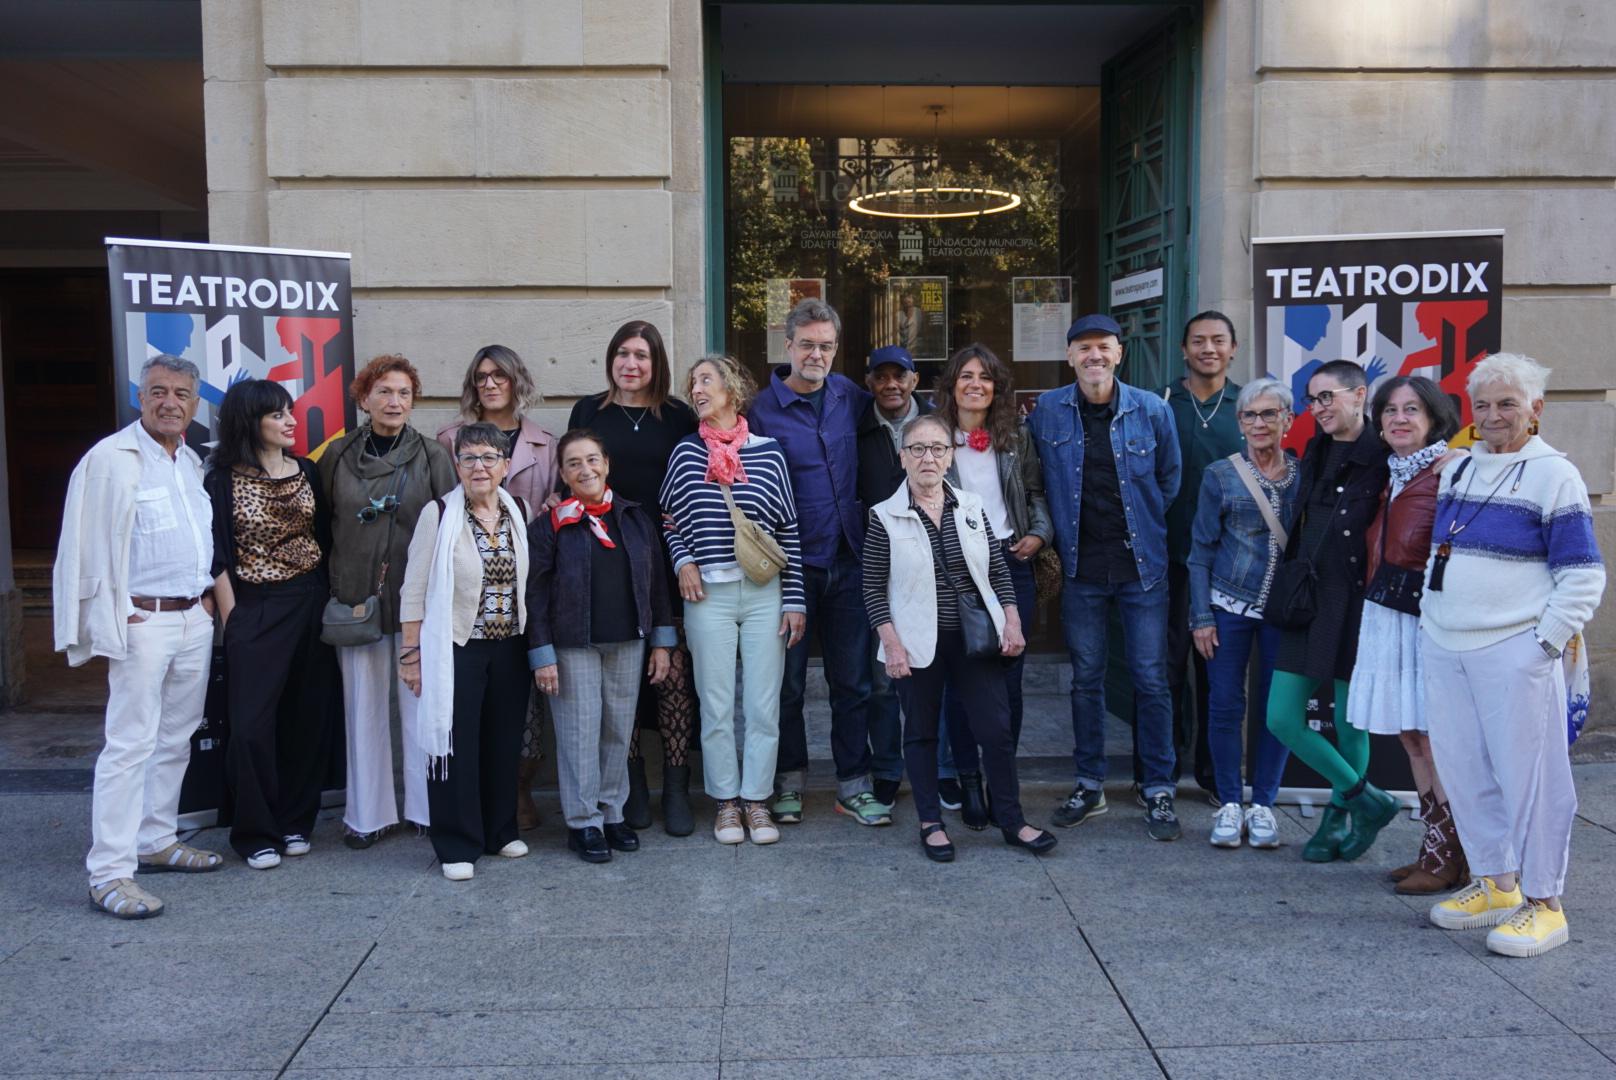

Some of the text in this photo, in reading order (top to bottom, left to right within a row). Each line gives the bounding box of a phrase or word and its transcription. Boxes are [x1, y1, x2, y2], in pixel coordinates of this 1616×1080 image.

[927, 236, 1039, 248] FUNDACIÓN MUNICIPAL
[928, 247, 962, 258] TEATRO
[1266, 262, 1489, 299] TEATRODIX
[123, 272, 340, 312] TEATRODIX
[920, 290, 943, 304] TRES
